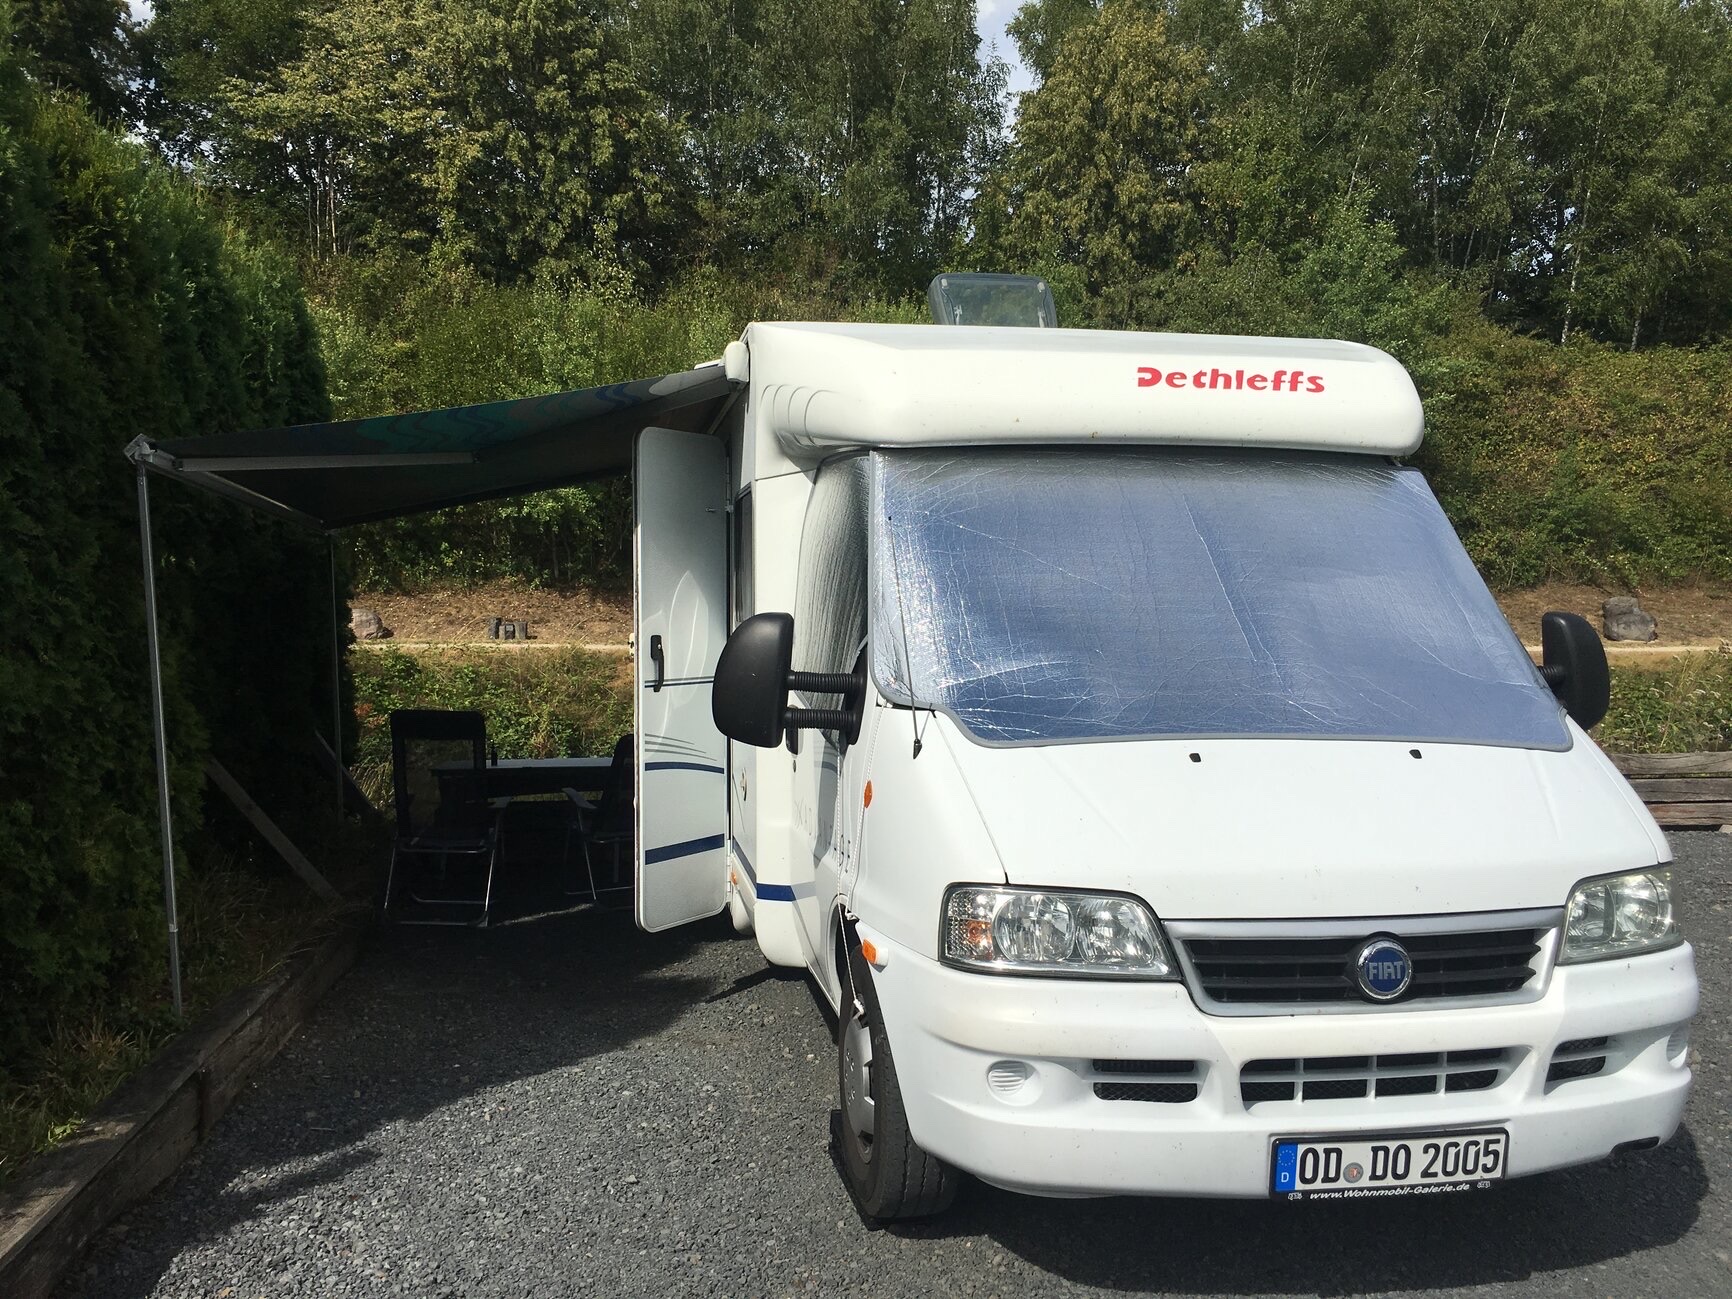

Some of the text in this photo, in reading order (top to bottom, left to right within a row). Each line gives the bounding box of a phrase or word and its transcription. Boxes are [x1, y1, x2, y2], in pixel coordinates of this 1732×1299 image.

[1137, 366, 1325, 393] Dethleffs
[1368, 961, 1404, 981] FIAT
[1299, 1138, 1501, 1185] OD DO 2005
[1280, 1172, 1290, 1183] D
[1309, 1183, 1470, 1199] www.Wohnmobil-Galerie.de
